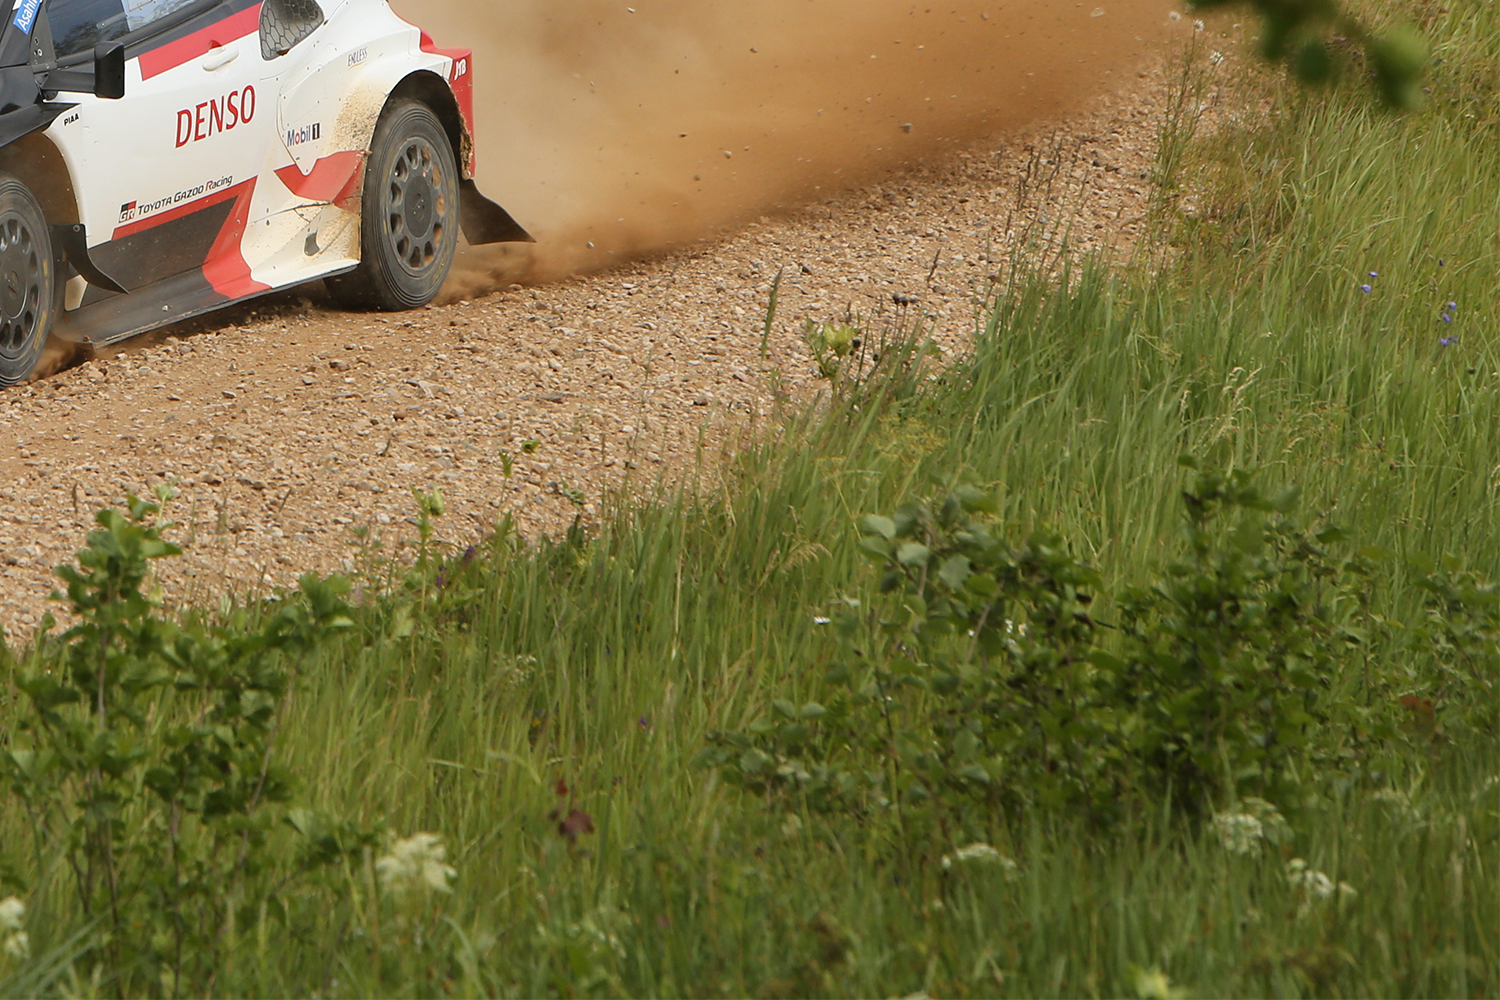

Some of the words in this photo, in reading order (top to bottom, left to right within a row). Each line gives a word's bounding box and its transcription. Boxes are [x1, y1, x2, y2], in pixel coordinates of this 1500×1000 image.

[63, 113, 79, 127] PIAA
[175, 84, 256, 149] DENSO
[286, 125, 311, 147] Mobil
[138, 196, 172, 215] TOYOTA
[174, 184, 204, 202] GAZOO
[205, 174, 233, 192] Racing
